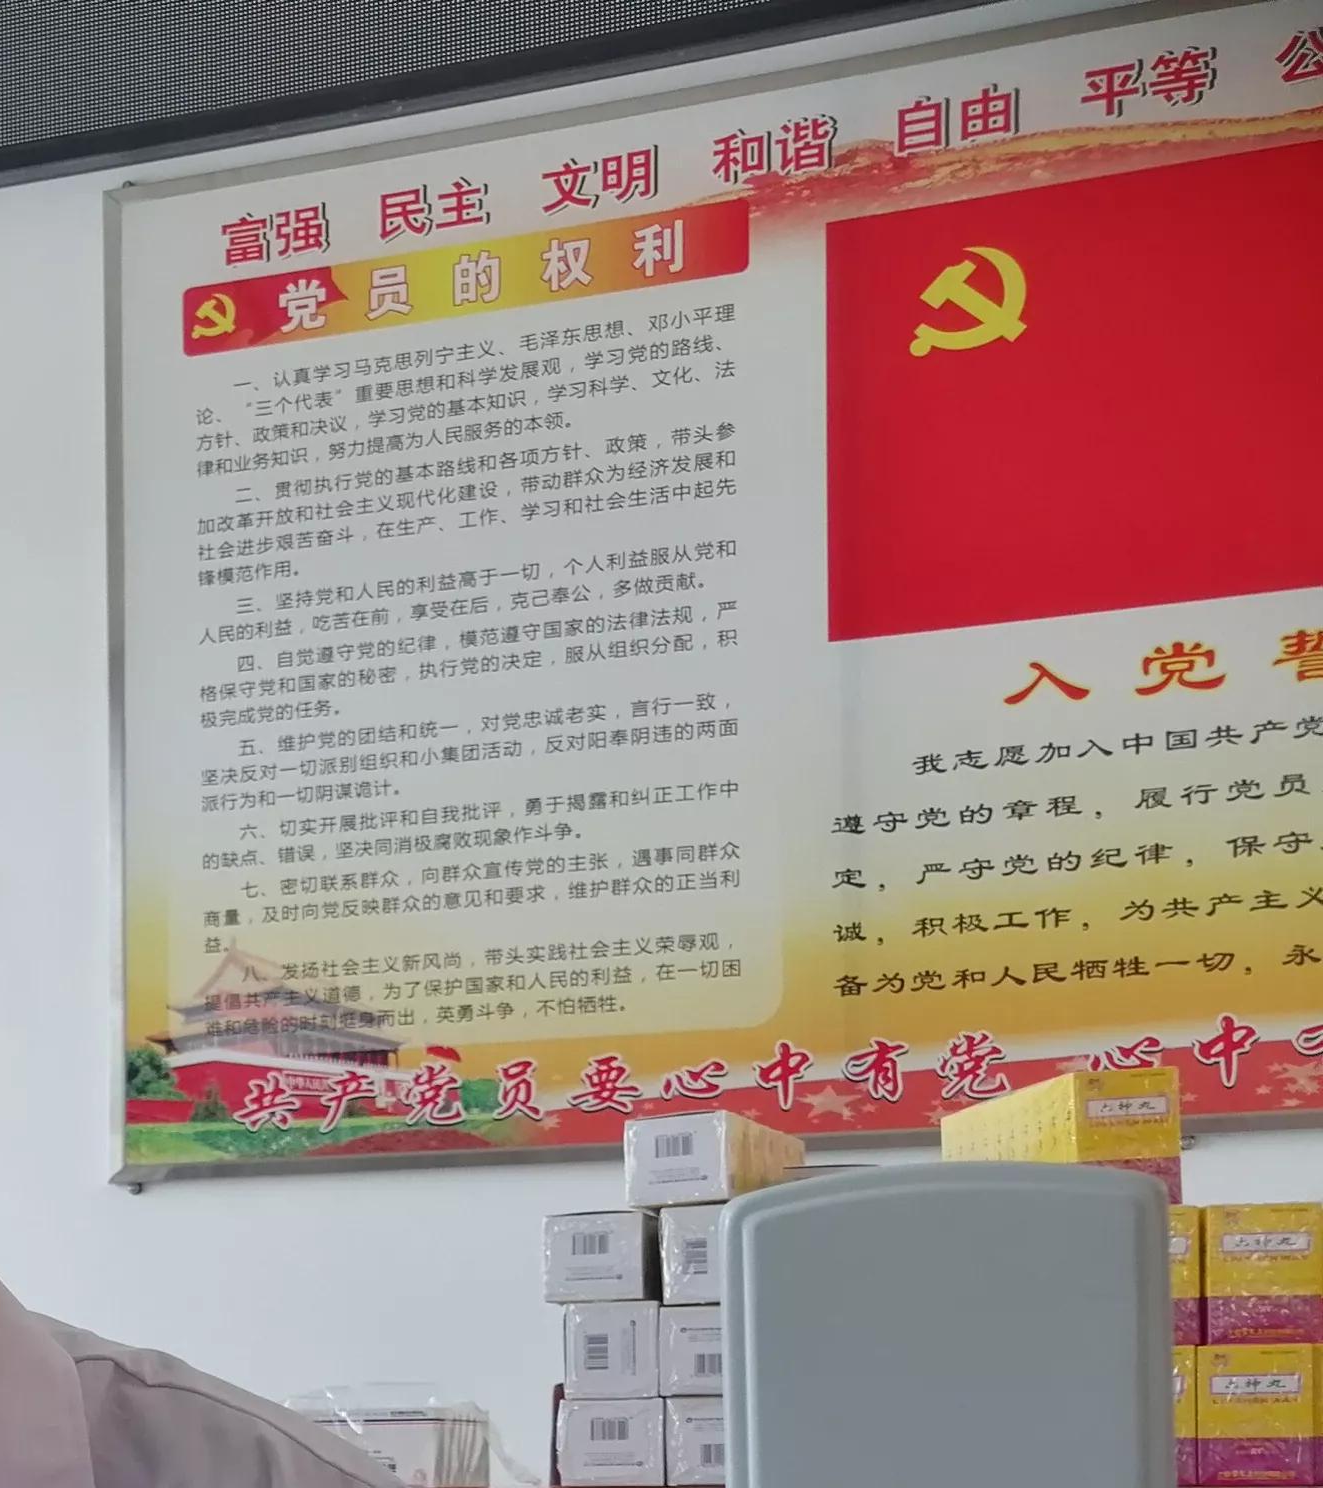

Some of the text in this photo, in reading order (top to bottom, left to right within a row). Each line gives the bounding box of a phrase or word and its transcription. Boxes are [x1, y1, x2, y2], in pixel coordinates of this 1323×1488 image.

[221, 201, 330, 268] 富强
[379, 177, 491, 244] 民主
[541, 145, 658, 214] 文明
[712, 114, 837, 185] 和谐
[894, 82, 1019, 157] 自由
[1081, 45, 1216, 118] 平等
[277, 219, 685, 334] 党员的权利
[234, 304, 736, 391] 一、认真学习马克思列宁主义、毛泽东思想、邓小平理
[196, 360, 736, 451] 方针、政策和决议，学习党的基本知识，学习科学、文化、法
[196, 411, 571, 478] 律和业务知识，努力提高为人民服务的本领。
[235, 422, 736, 503] 二、贯彻执行党的基本路线和各项方针、政策，带头参
[197, 450, 736, 535] 加改革开放和社会主义现代化建设，带动群众为经济发展和
[198, 478, 737, 562] 社会进步艰苦奋斗，在生产、工作、学习和社会生活中起先
[198, 560, 299, 587] 锋模范作用。
[236, 539, 737, 614] 三、坚持党和人民的利益高于一切，个人利益服从党和
[199, 572, 705, 646] 人民的利益，吃苦在前，享受在后，克己奉公，多做贡献。
[237, 600, 738, 673] 四、自觉遵守党的纪律，模范遵守国家的法律法规，严
[200, 629, 739, 702] 格保守党和国家的秘密，执行党的决定，服从组织分配，积
[201, 700, 341, 728] 极完成党的任务。
[238, 692, 731, 757] 五、维护党的团结和统一，对党忠诚老实，言行一致，
[912, 715, 1323, 776] 我志愿加入中国共产党
[201, 718, 738, 787] 坚决反对一切派别组织和小集团活动，反对阳奉阴违的两面
[202, 779, 401, 812] 派行为和一切阴谋诡计。
[240, 779, 739, 840] 六、切实开展批评和自我批评，勇于揭露和纠正工作中
[831, 773, 1323, 836] 遵守党的章程，履行党员
[202, 822, 582, 870] 的缺点、错误，坚决同消极腐败现象作斗争。
[241, 841, 740, 899] 七、密切联系群众，向群众宣传党的主张，遇事同群众
[831, 831, 1323, 893] 定，严守党的纪律，保守
[203, 869, 741, 928] 商量，及时向党反映群众的意见和要求，维护群众的正当利
[833, 886, 1323, 947] 诚，积极工作，为共产主义
[205, 936, 230, 954] 益。
[242, 932, 735, 982] 八、发扬社会主义新风尚，带头实践社会主义荣辱观，
[833, 944, 1323, 998] 备为党和人民牺牲一切，永
[234, 1031, 1011, 1132] 共产党员要心中有党
